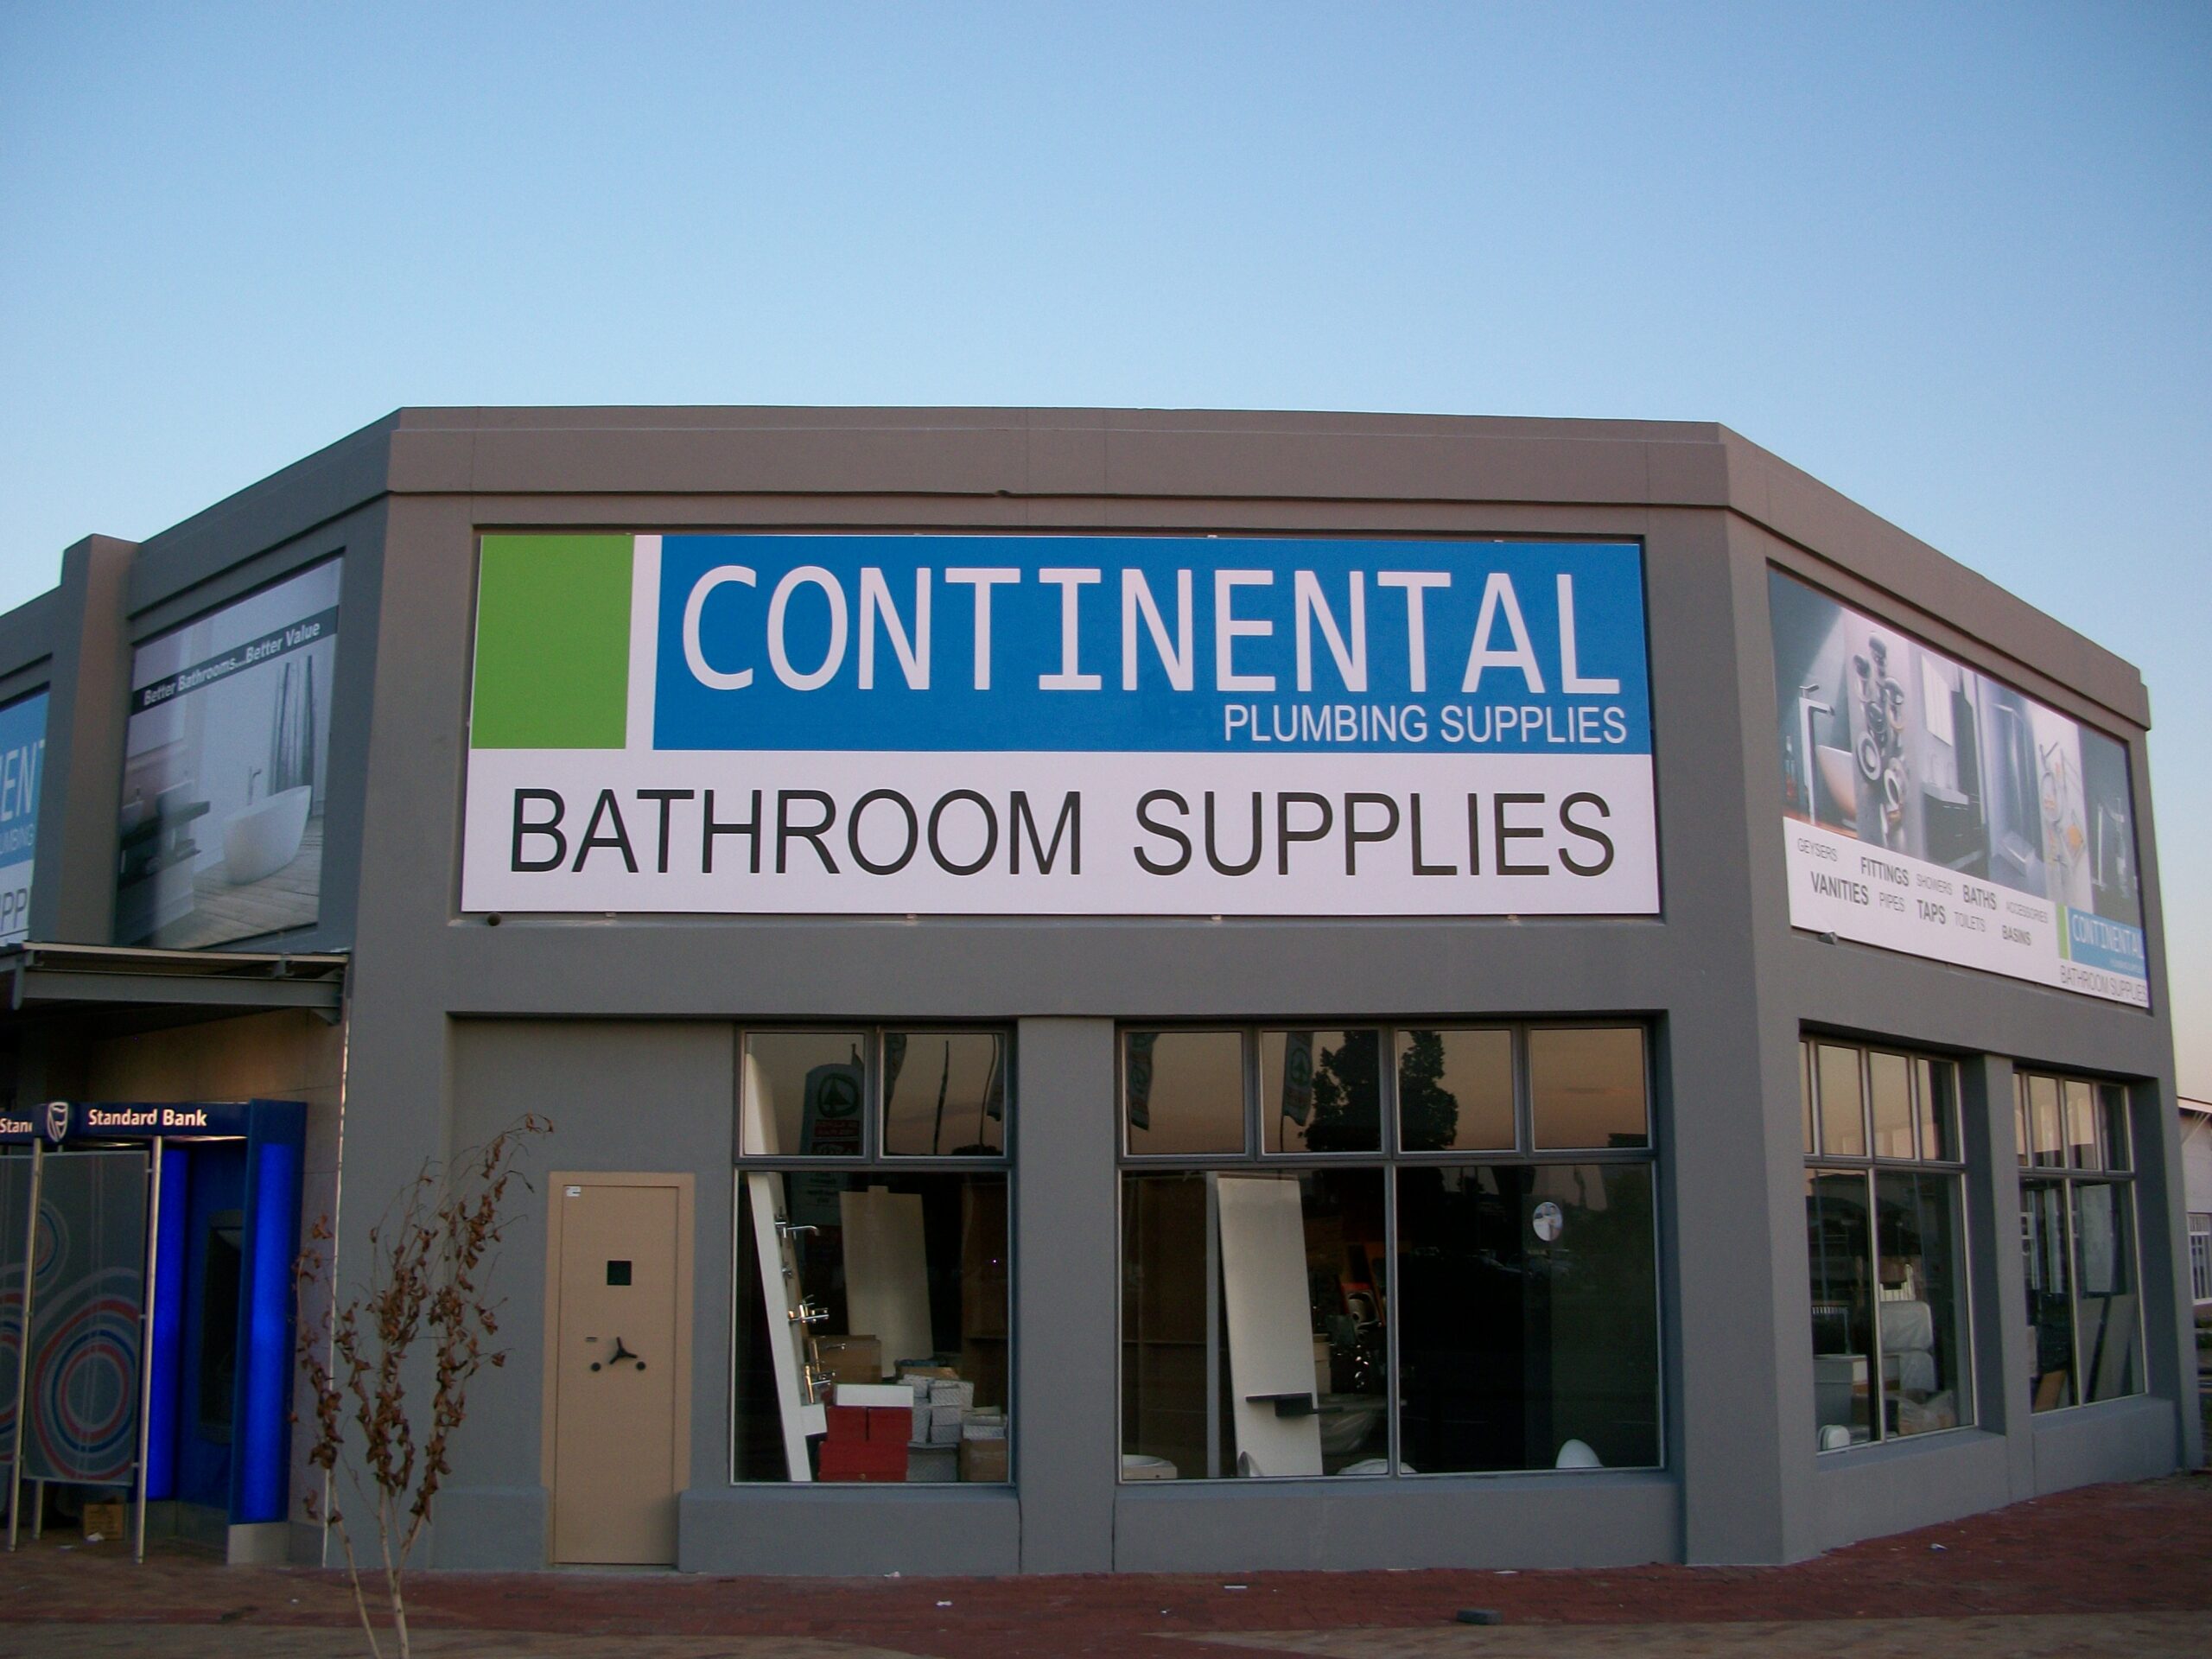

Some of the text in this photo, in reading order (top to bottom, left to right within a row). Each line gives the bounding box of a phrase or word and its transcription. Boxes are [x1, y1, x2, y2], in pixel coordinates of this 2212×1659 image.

[143, 681, 175, 706] Better
[286, 622, 321, 646] Value
[683, 565, 1620, 694] CONTINENTAL
[1224, 704, 1627, 743] PLUMBING SUPPLIES
[0, 740, 45, 822] EN
[511, 788, 1614, 877] BATHROOM SUPPLIES
[1797, 837, 1838, 862] GEYSERS
[1811, 871, 2031, 946] VANITIES PIPES TAPS TOILETS BASINS
[1860, 856, 1910, 887] FITTINGS
[1916, 873, 1953, 896] SHOWERS
[1962, 884, 1997, 911] BATHS
[88, 1109, 207, 1127] Standard Bank
